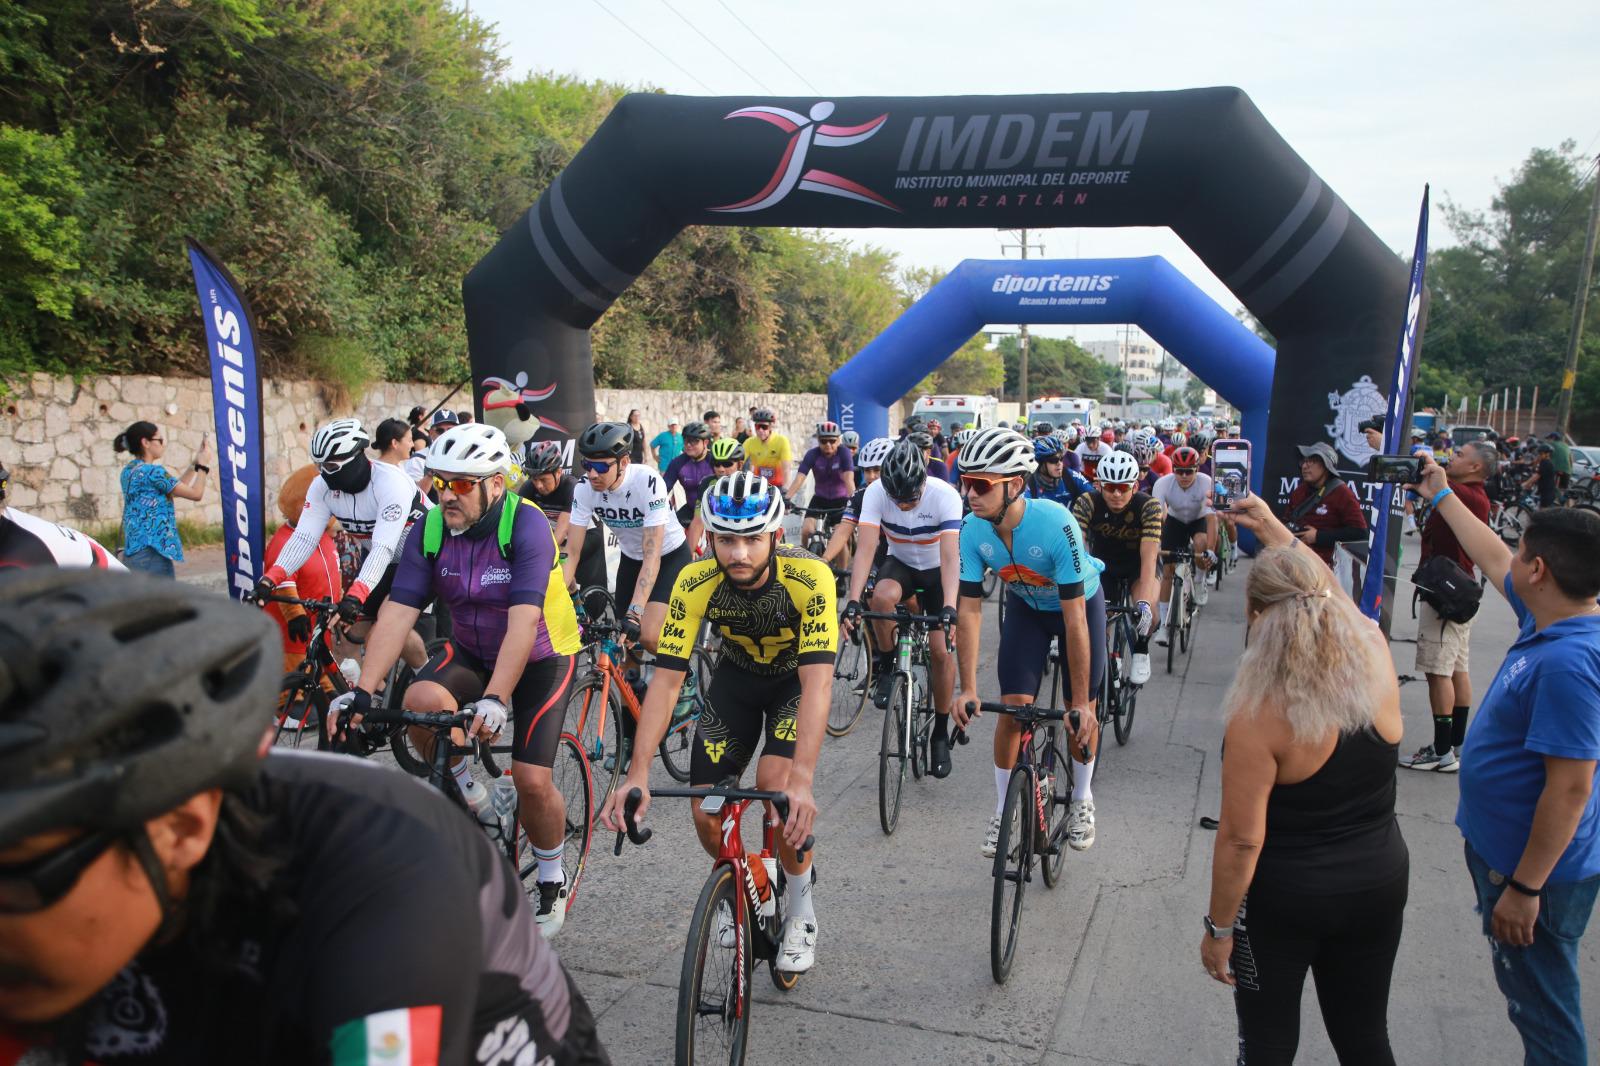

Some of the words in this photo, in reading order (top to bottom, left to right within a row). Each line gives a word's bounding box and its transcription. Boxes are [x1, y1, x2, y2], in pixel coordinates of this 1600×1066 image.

[897, 110, 1150, 172] IMDEM
[895, 175, 963, 189] INSTITUTO
[965, 173, 1038, 188] MUNICIPAL
[1041, 173, 1066, 186] DEL
[1068, 171, 1131, 185] DEPORTE
[933, 190, 1088, 208] MAZATLÁN
[992, 274, 1113, 295] dportenis
[594, 506, 645, 521] BORA
[1062, 524, 1076, 548] BIKE
[1071, 548, 1081, 574] SHOP
